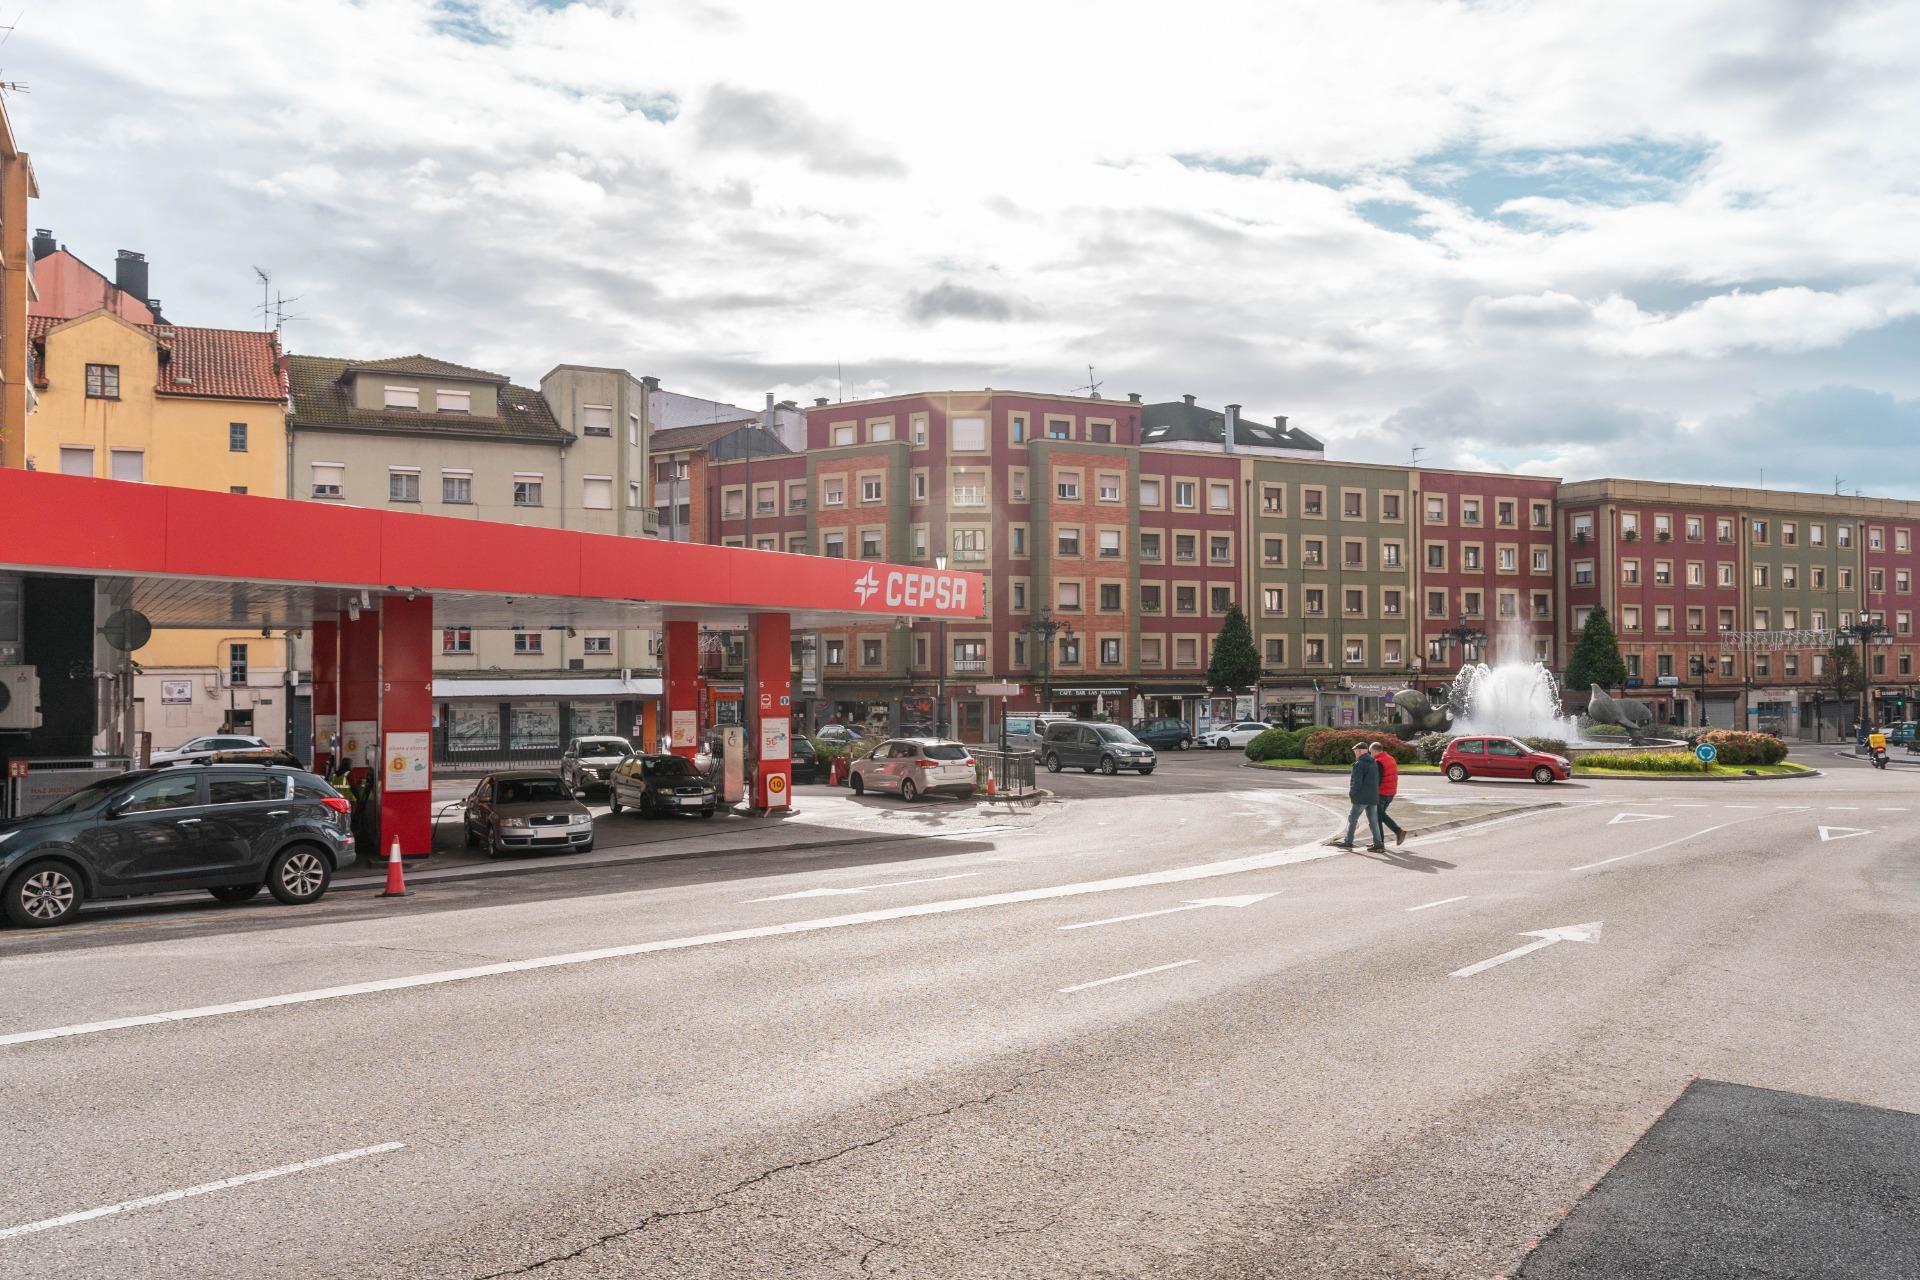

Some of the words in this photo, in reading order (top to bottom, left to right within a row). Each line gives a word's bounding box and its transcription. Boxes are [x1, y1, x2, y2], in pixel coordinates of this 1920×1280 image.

[886, 572, 967, 609] CEPSA
[384, 683, 391, 692] 3
[425, 683, 431, 692] 4
[393, 757, 403, 770] 6
[772, 780, 781, 788] 10
